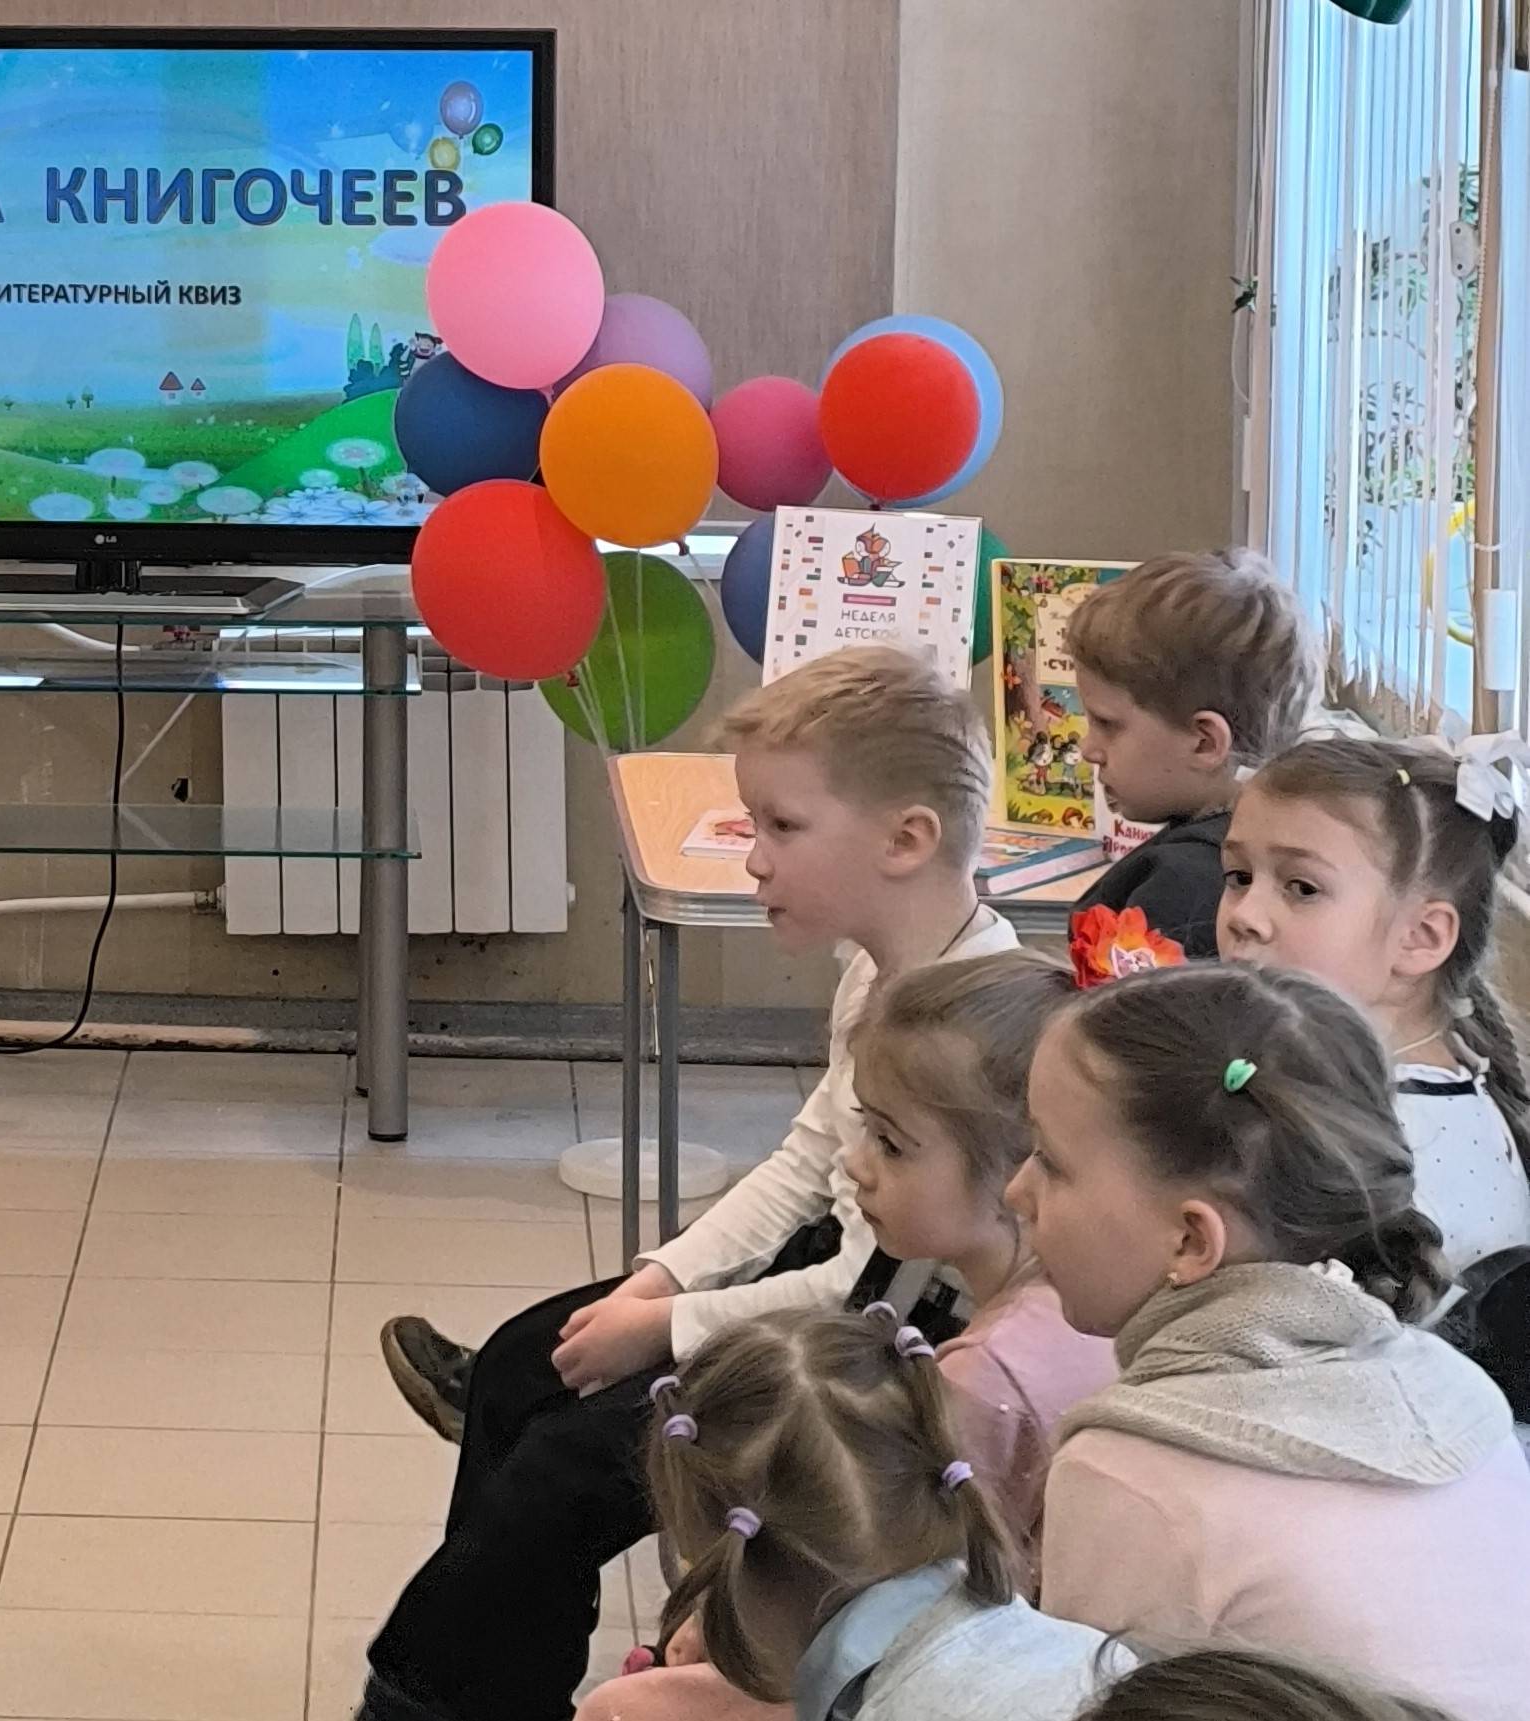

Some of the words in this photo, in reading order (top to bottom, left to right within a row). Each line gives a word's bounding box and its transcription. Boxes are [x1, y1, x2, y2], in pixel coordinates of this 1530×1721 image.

[46, 167, 467, 226] КНИГОЧЕЕВ
[178, 285, 242, 305] КВИЗ
[841, 610, 896, 622] НЕДЕЛЯ
